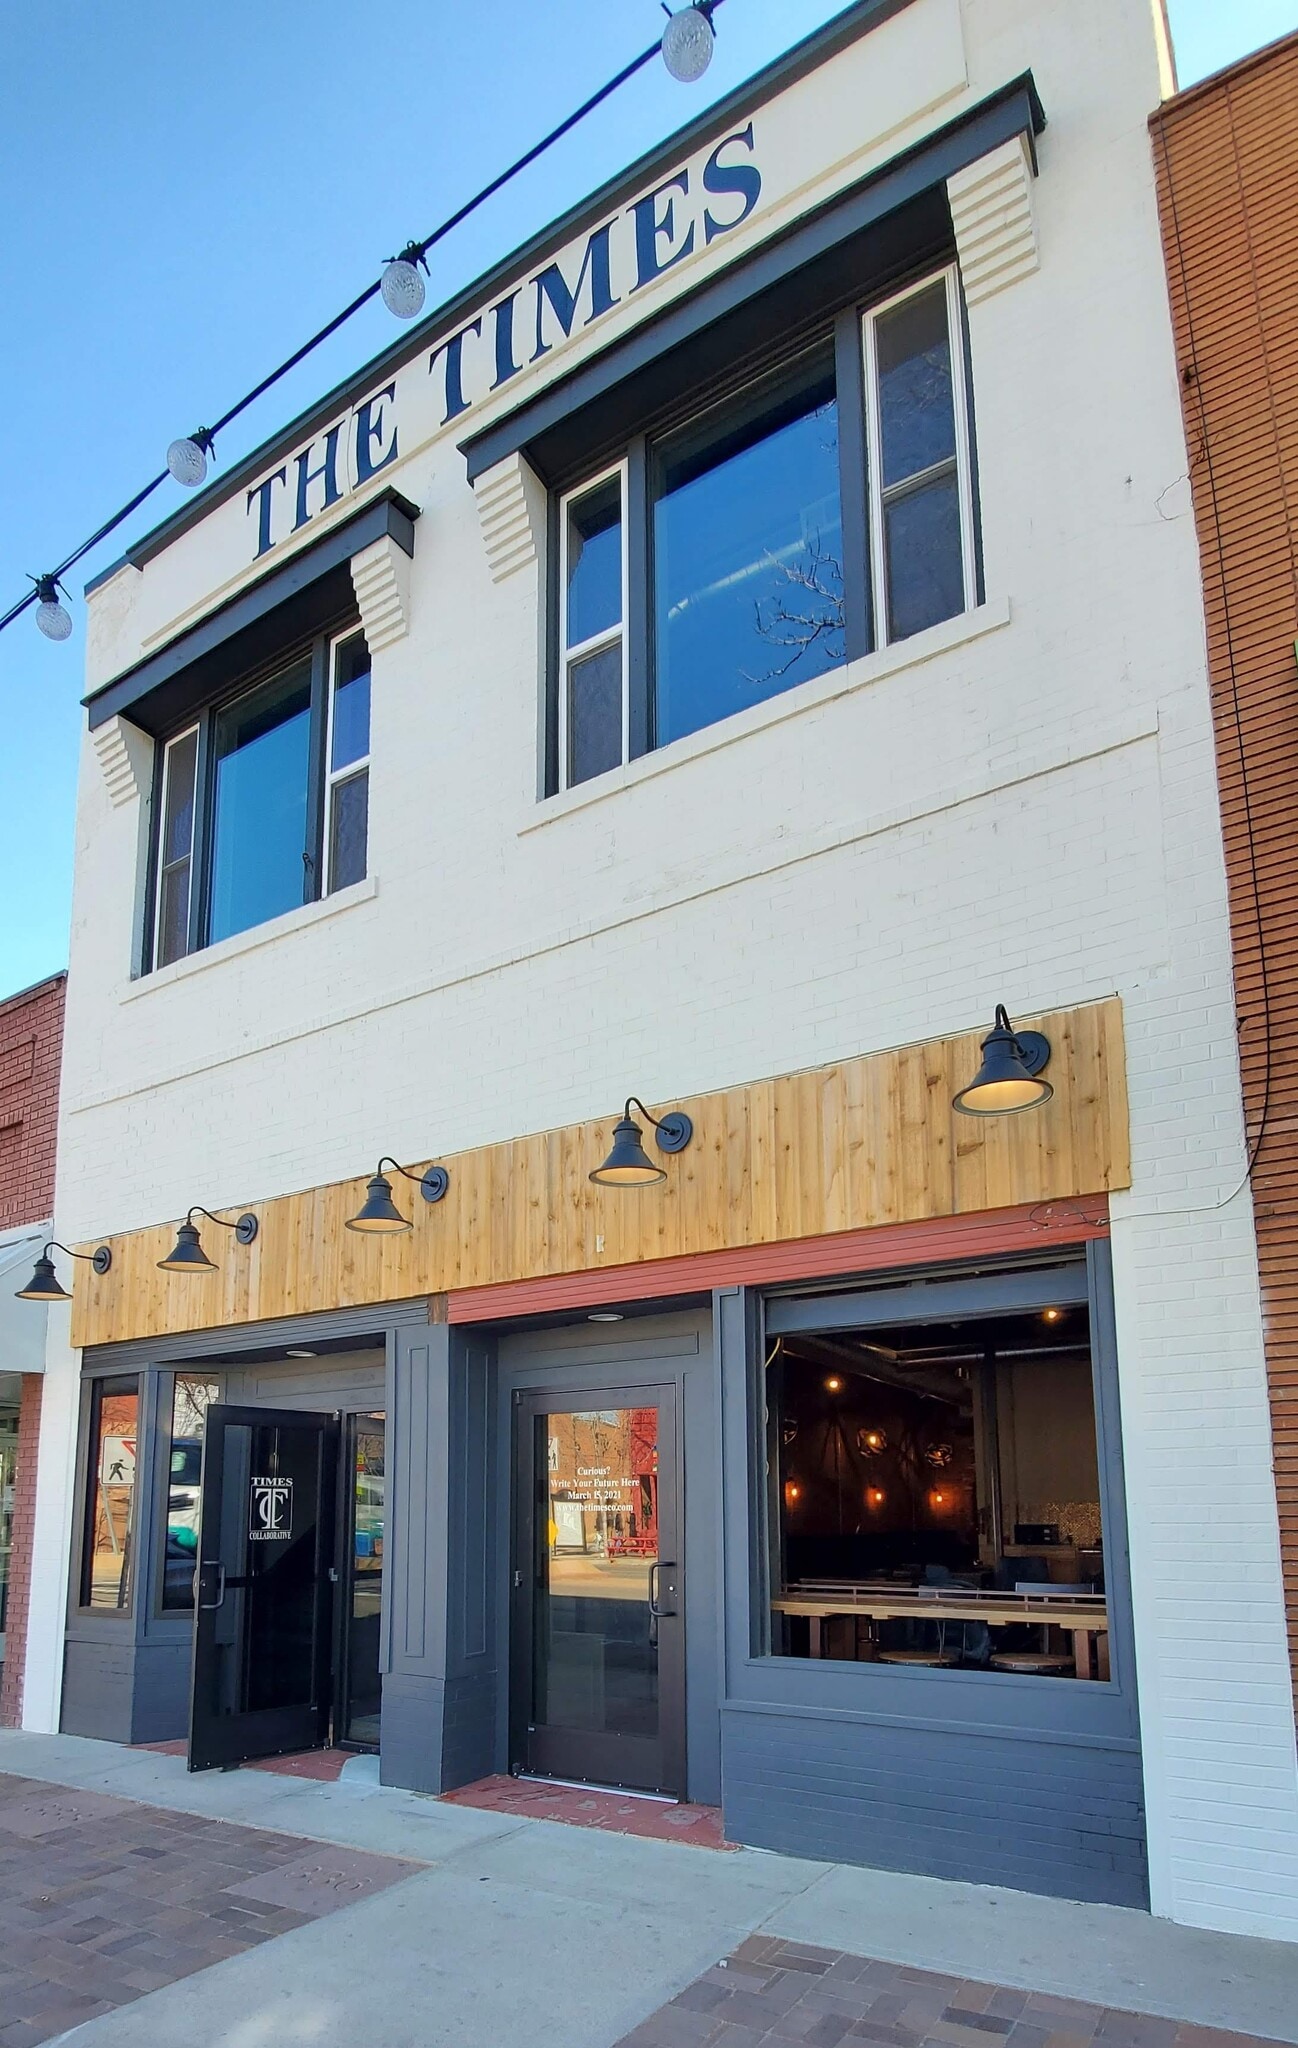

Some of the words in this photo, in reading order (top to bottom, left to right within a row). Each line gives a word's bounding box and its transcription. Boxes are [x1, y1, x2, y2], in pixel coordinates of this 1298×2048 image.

[246, 380, 399, 561] THE
[428, 120, 763, 428] TIMES
[577, 1466, 611, 1476] Curious?
[251, 1477, 294, 1486] TIMES
[550, 1479, 571, 1488] Write
[573, 1479, 593, 1488] Your
[593, 1478, 620, 1487] Future
[621, 1477, 640, 1487] Here
[567, 1490, 592, 1500] March
[604, 1490, 621, 1499] 2021
[249, 1531, 292, 1541] COLLABORATIVE
